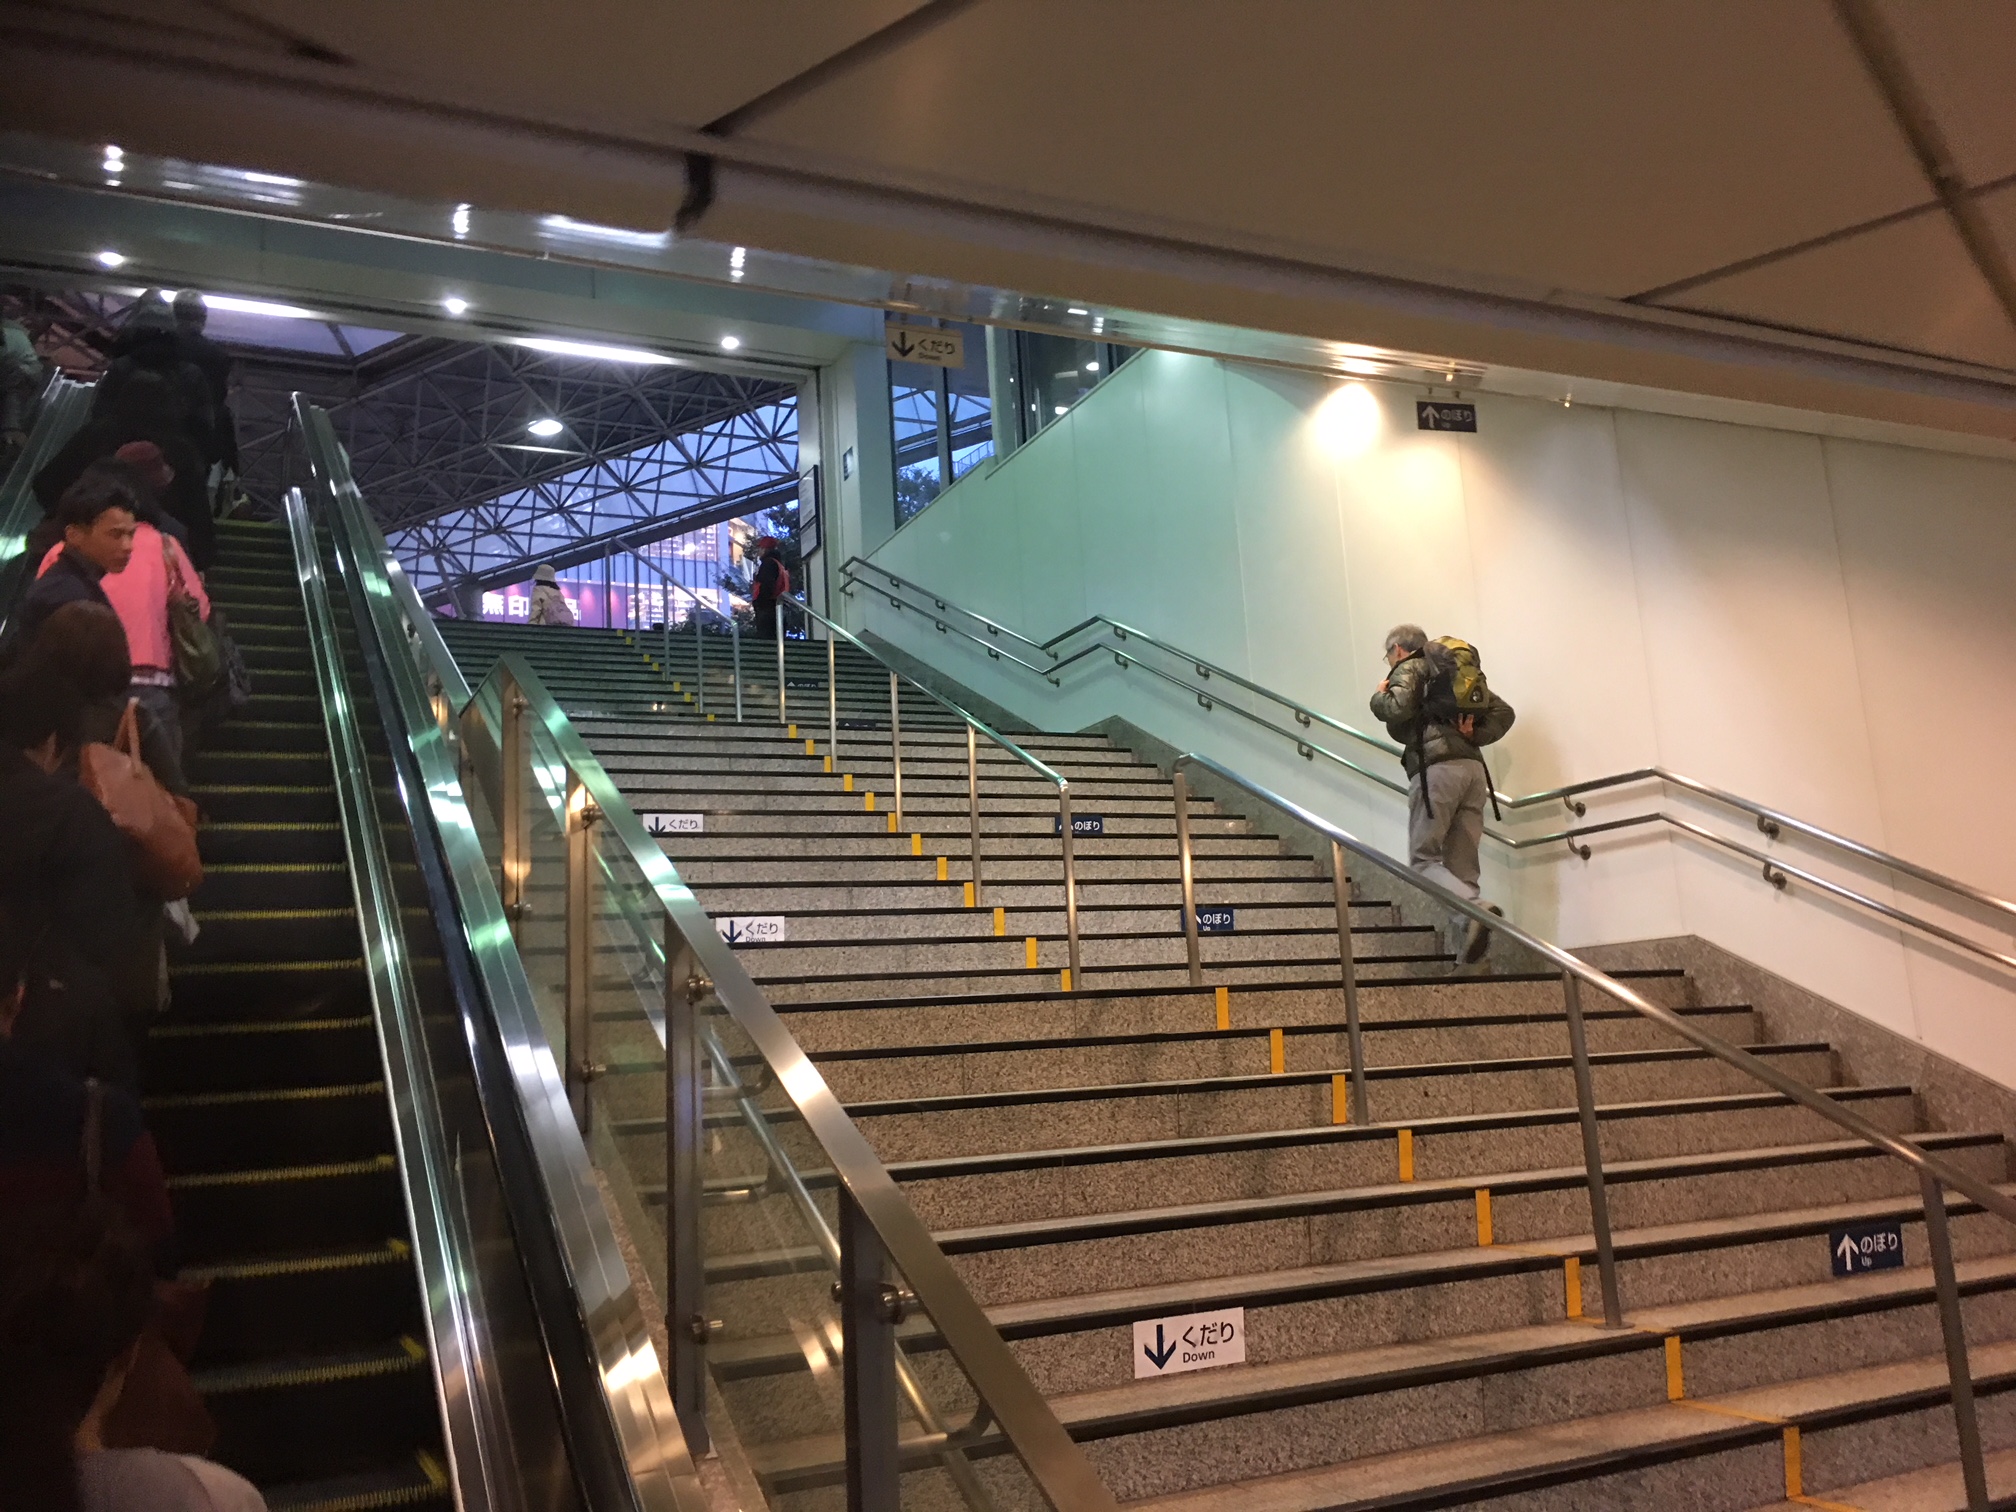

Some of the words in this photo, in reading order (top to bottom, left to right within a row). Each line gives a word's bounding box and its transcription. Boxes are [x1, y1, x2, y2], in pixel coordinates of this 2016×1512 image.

[918, 338, 956, 355] くだり
[1440, 409, 1473, 422] のぼり
[669, 819, 698, 830] くだり
[1074, 820, 1100, 831] のぼり
[1202, 913, 1231, 925] のぼり
[745, 921, 778, 935] くだり
[1860, 1231, 1898, 1254] のぼり
[1861, 1256, 1873, 1268] Up
[1182, 1321, 1235, 1348] くだり
[1182, 1350, 1215, 1363] Down
